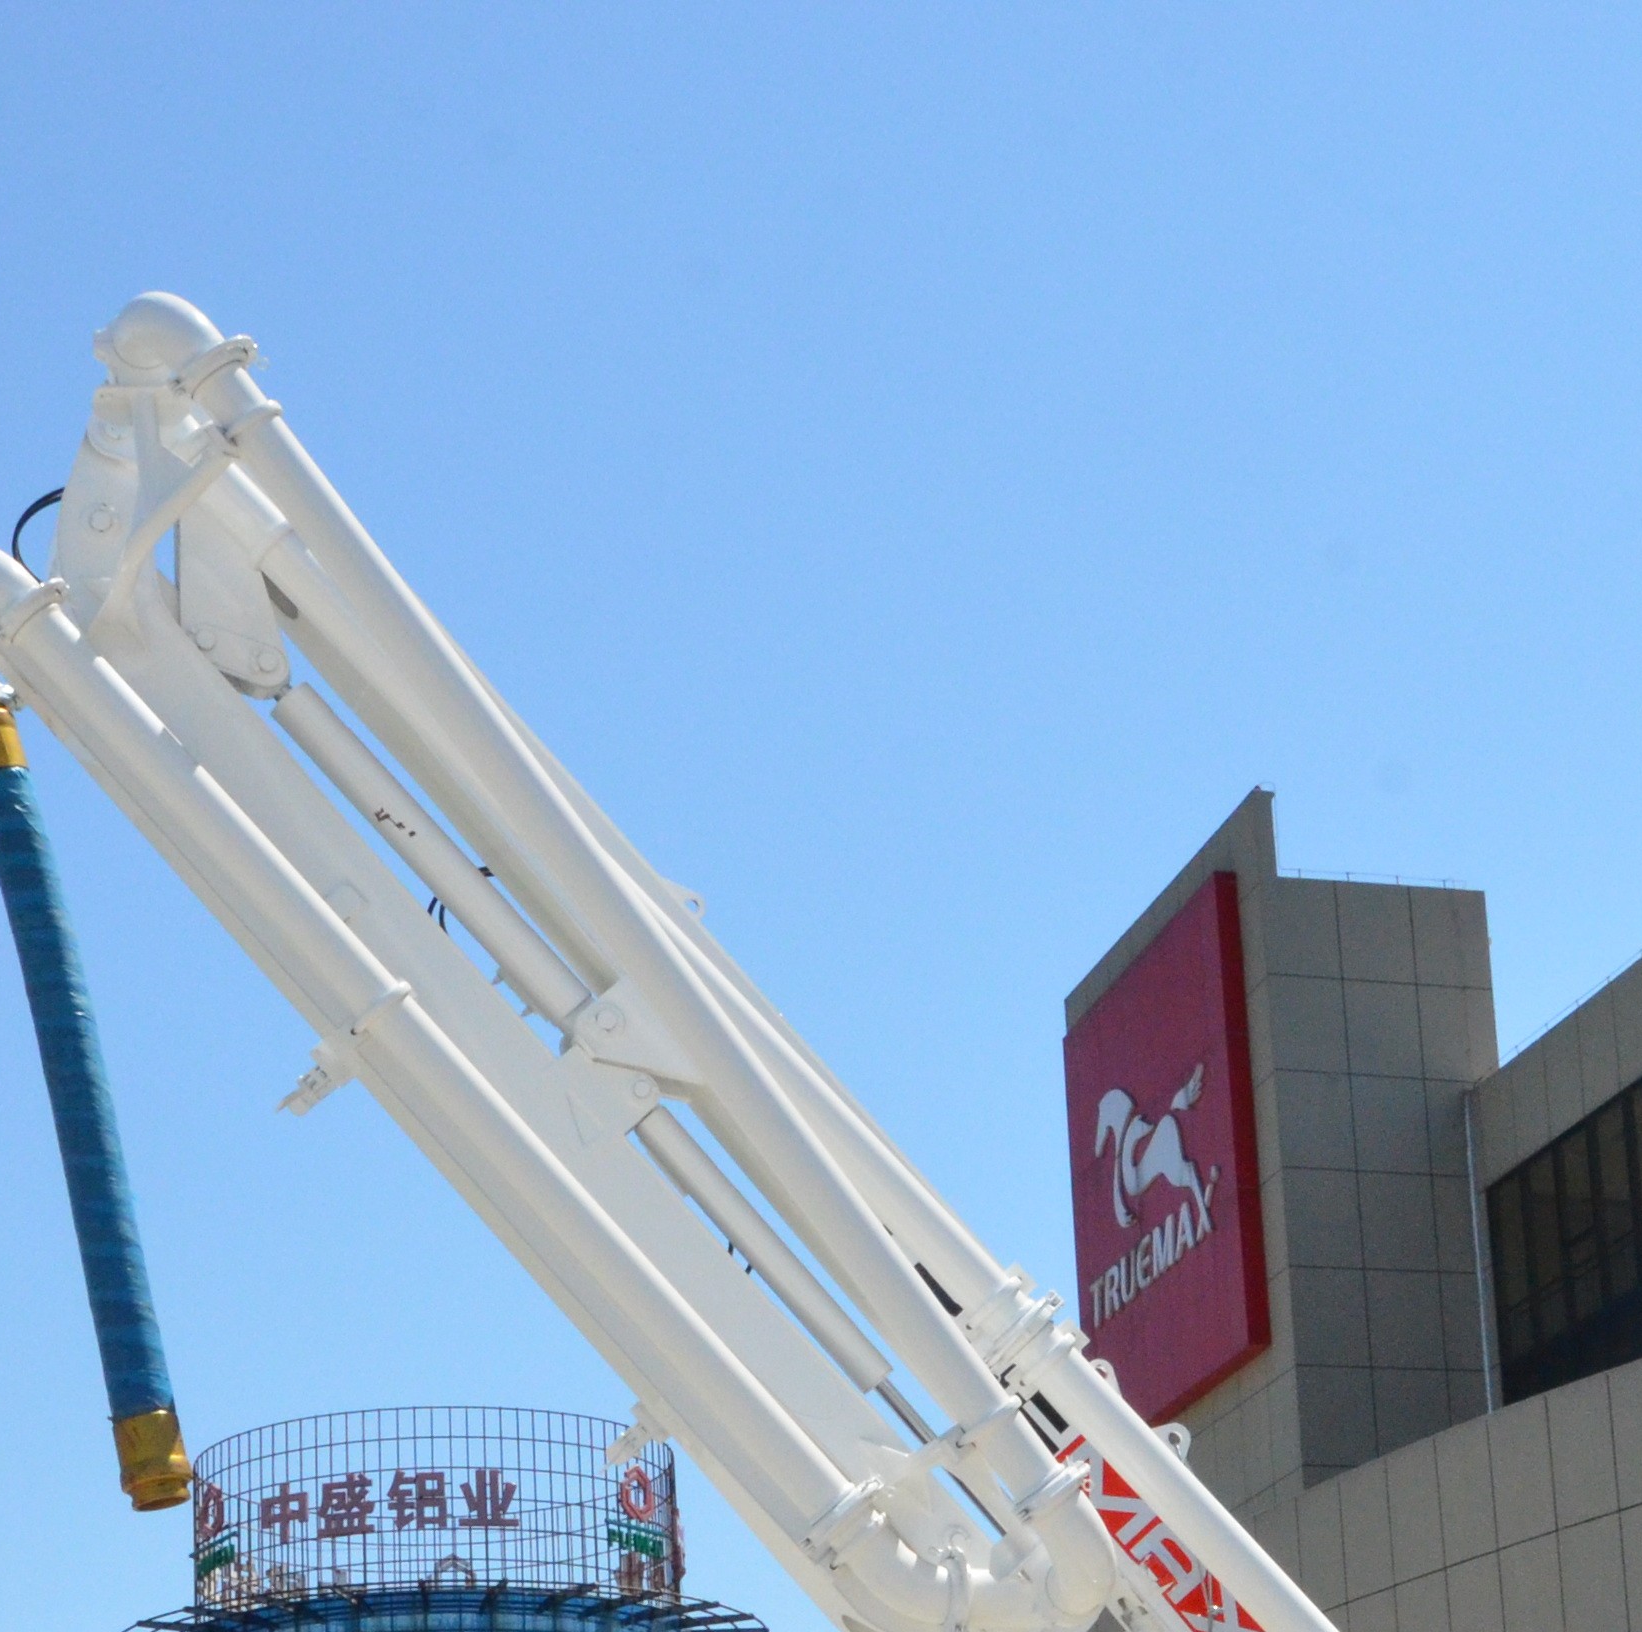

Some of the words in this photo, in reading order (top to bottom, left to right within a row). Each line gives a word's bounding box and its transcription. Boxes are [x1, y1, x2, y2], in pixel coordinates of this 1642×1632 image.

[1090, 1183, 1215, 1330] TRUEMAX
[260, 1466, 520, 1545] 中盛铝业
